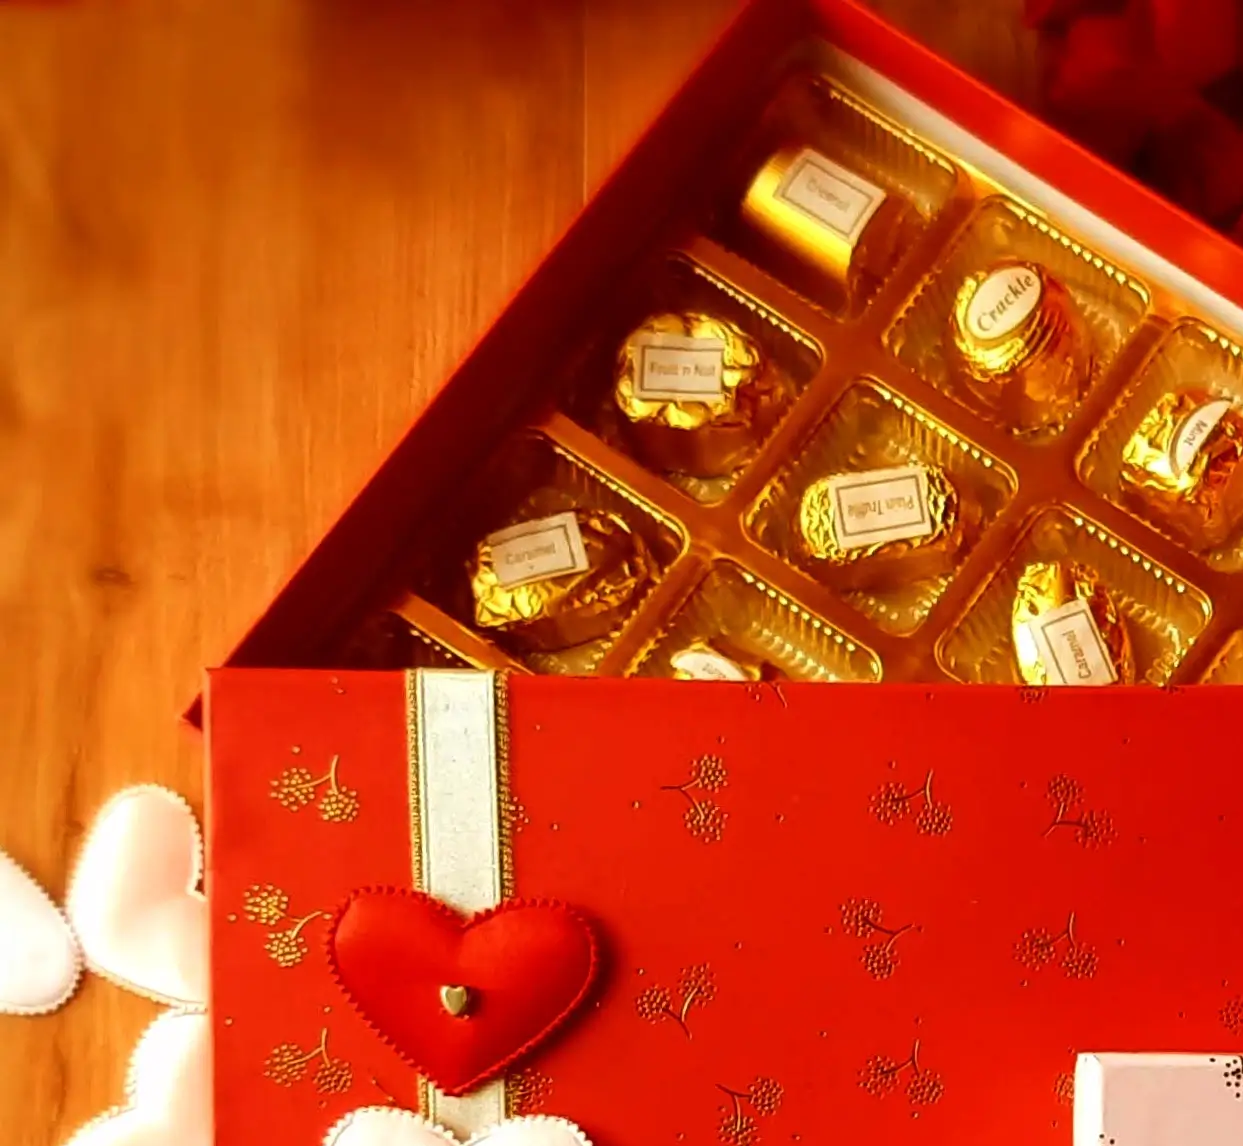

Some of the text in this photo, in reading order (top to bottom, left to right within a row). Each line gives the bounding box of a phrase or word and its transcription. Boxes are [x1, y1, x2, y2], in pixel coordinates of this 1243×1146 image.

[977, 275, 1034, 332] Crackle
[1183, 420, 1209, 446] Mint
[884, 494, 915, 511] Plain
[1061, 630, 1092, 679] Caramel
